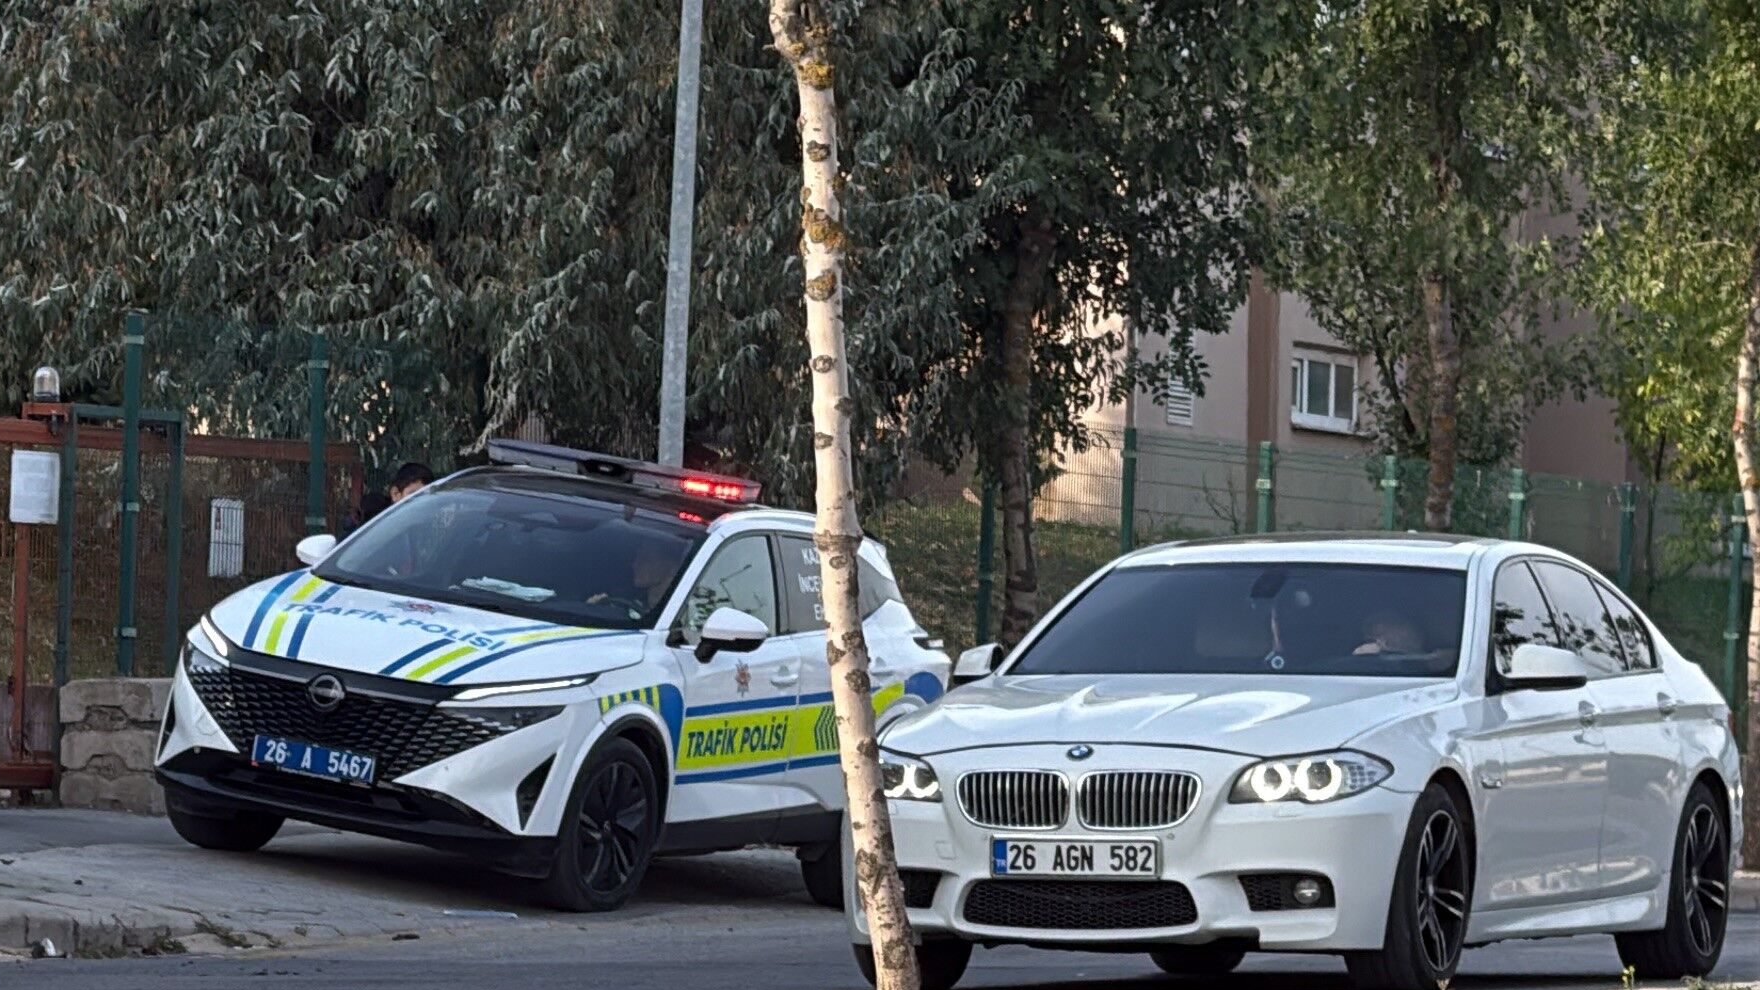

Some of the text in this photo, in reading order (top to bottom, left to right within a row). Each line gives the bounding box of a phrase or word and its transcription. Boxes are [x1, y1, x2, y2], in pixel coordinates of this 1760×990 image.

[284, 604, 394, 623] TRAFİK
[687, 715, 789, 758] TRAFİK POLİSİ
[264, 739, 287, 764] 26
[300, 747, 312, 769] A
[328, 751, 372, 780] 5467
[1009, 844, 1036, 870] 26
[1052, 844, 1094, 871] AGN
[1109, 845, 1153, 872] 582
